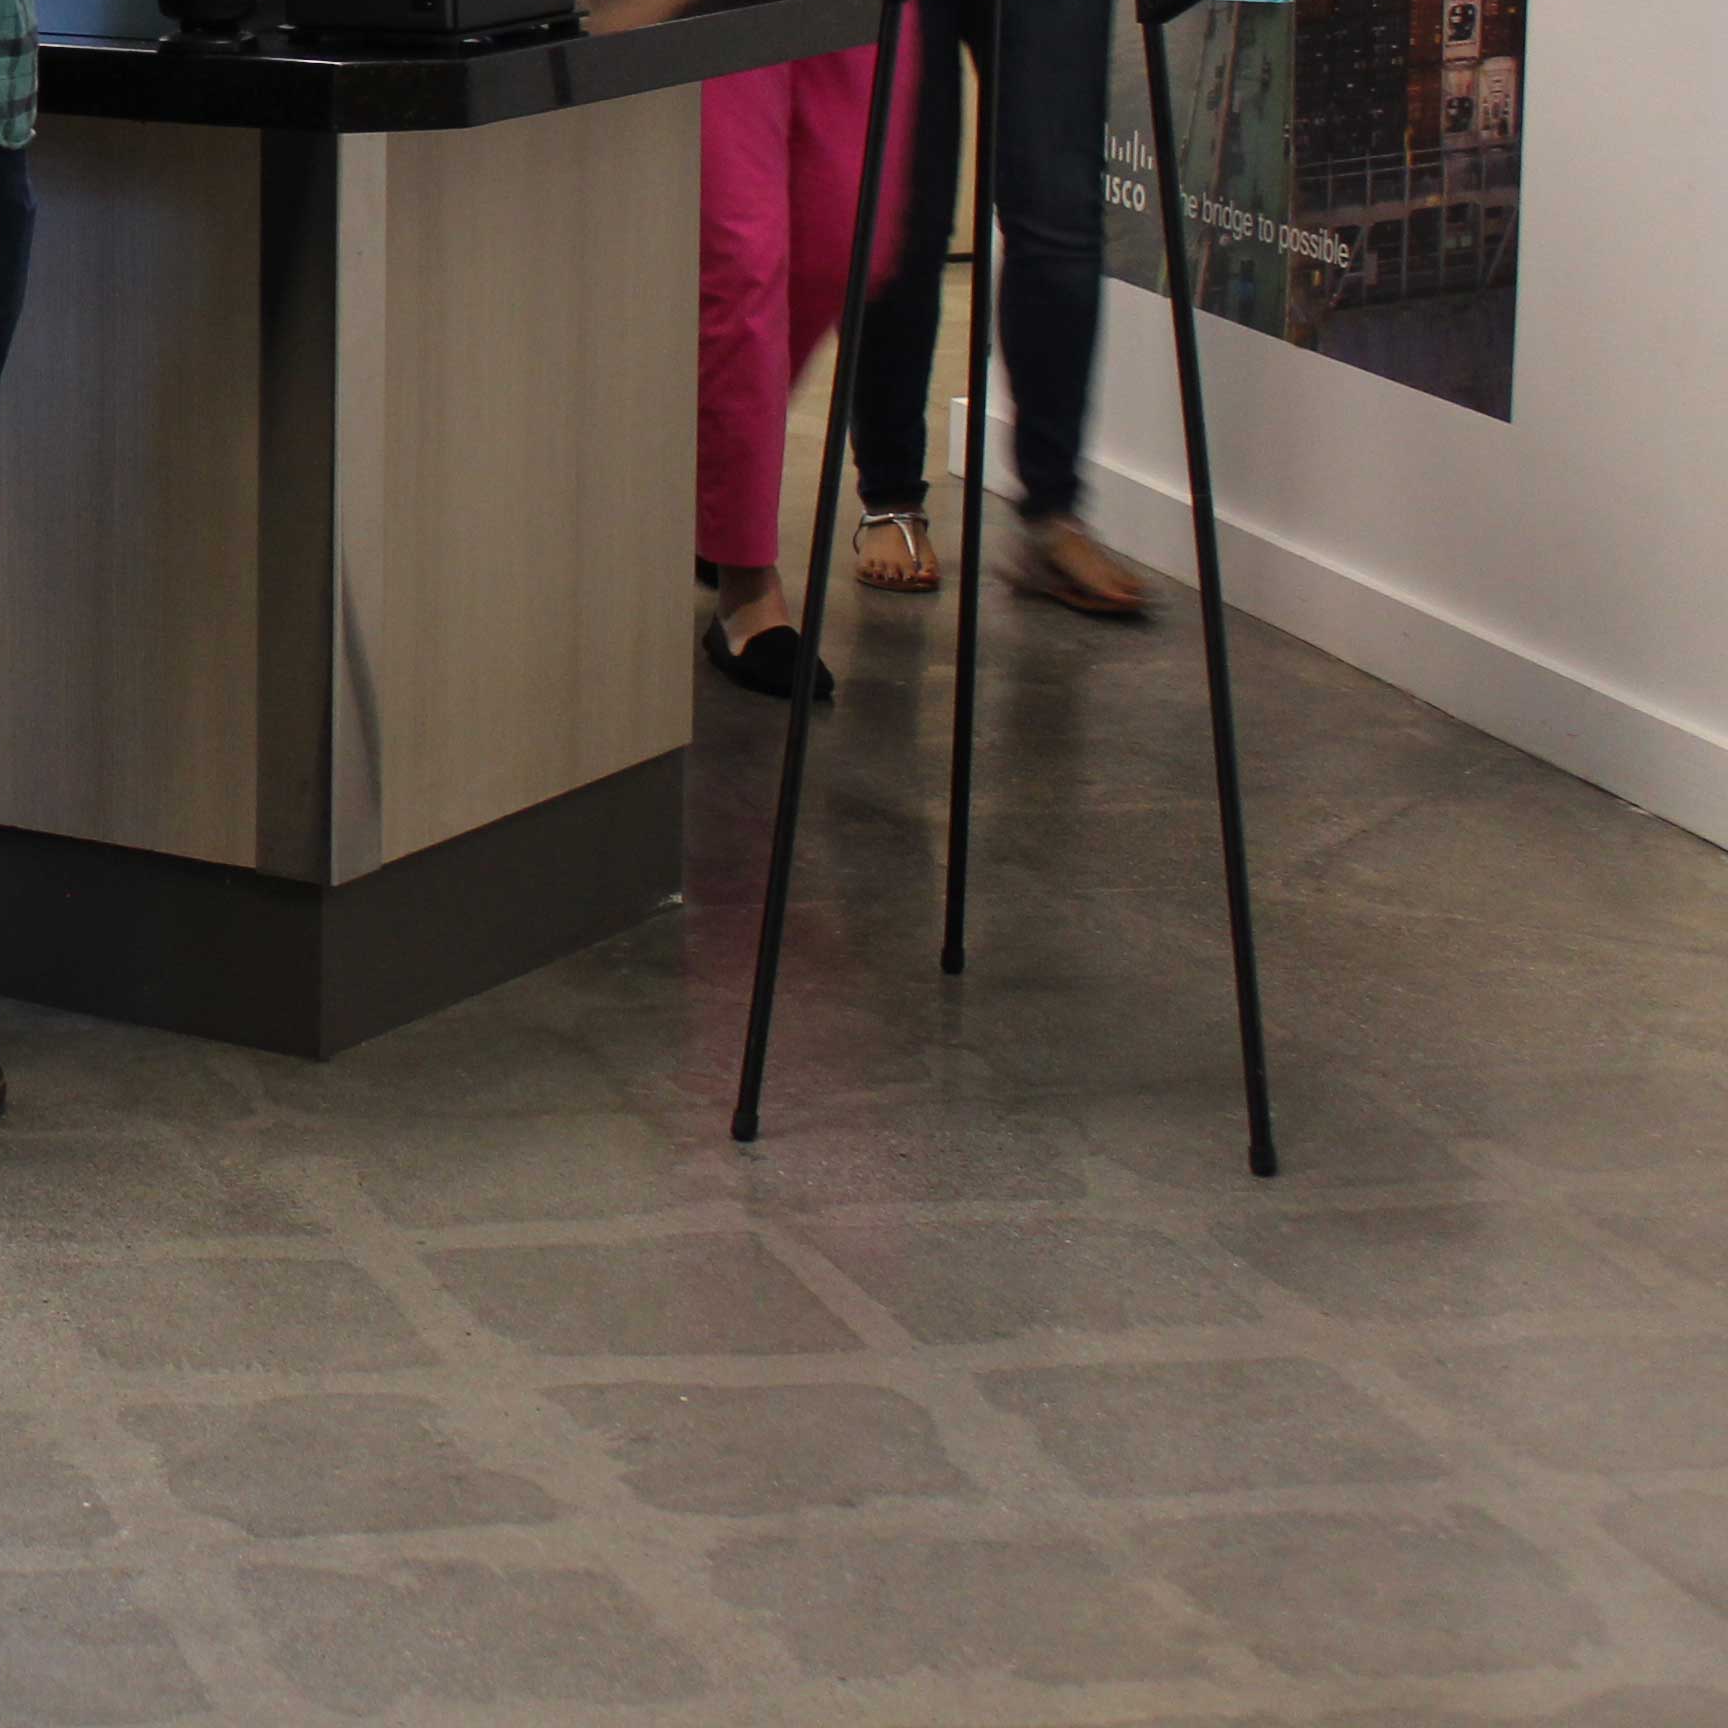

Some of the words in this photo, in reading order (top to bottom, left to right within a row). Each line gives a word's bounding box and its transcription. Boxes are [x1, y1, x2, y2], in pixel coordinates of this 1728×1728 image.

[1101, 173, 1146, 212] ISCO
[1179, 183, 1198, 219] he
[1202, 191, 1253, 241] bridge
[1258, 212, 1274, 243] to
[1279, 223, 1351, 268] possible
